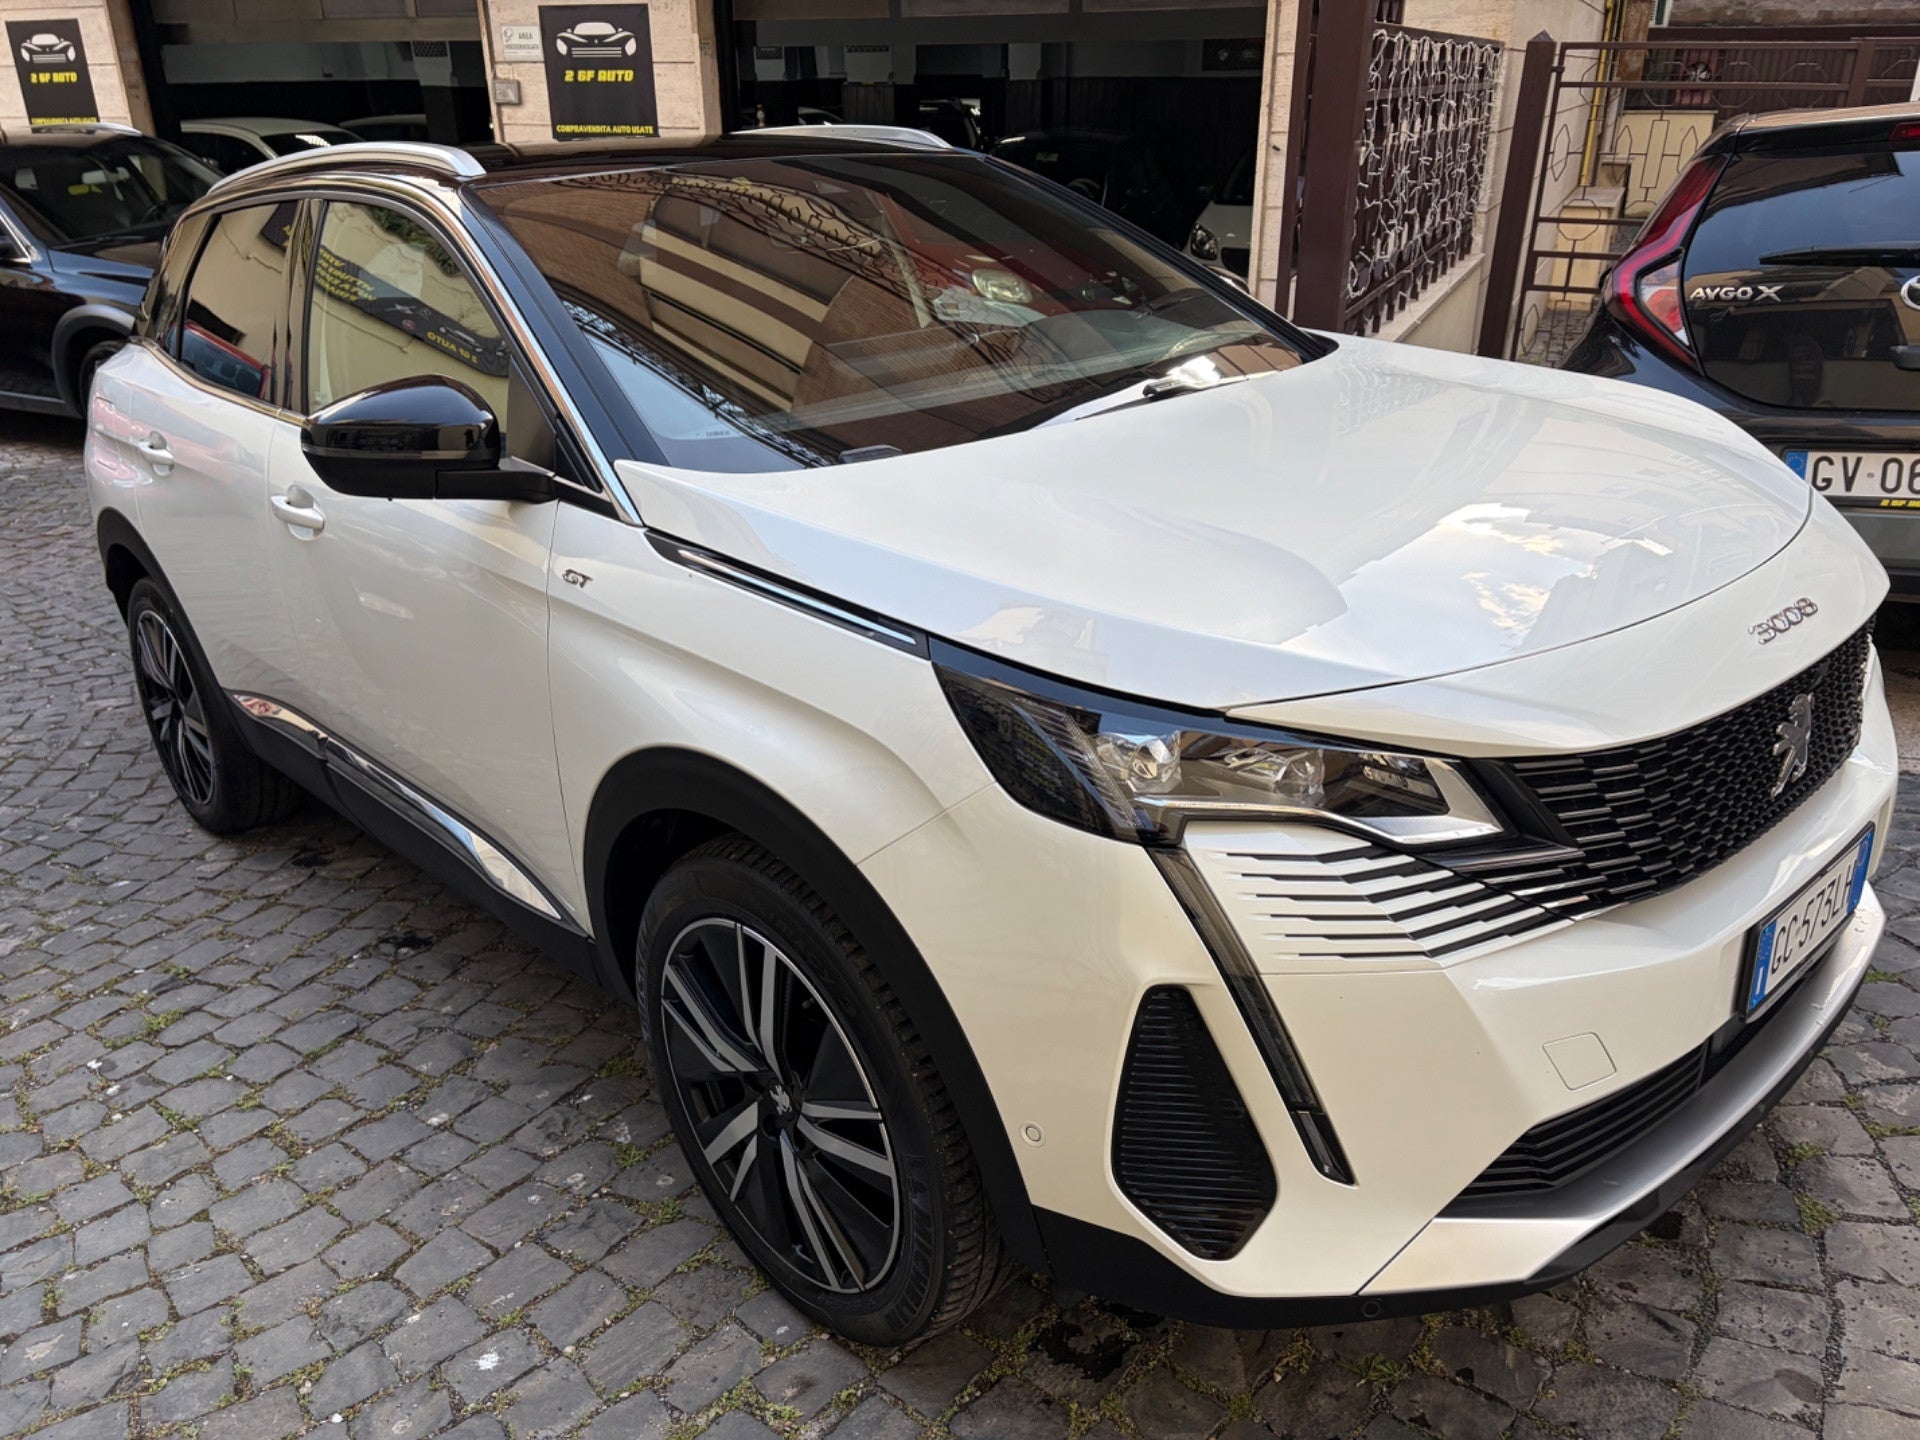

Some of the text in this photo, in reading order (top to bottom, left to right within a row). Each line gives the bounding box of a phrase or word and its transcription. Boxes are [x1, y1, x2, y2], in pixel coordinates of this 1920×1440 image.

[30, 72, 38, 84] 2
[52, 71, 78, 83] AUTO
[564, 69, 634, 82] 2 GF AUTO
[556, 124, 654, 134] COMPRAVENDITA AUTO USATE
[1689, 284, 1785, 303] AYGO X
[562, 569, 593, 588] GT
[1747, 597, 1819, 645] 3008
